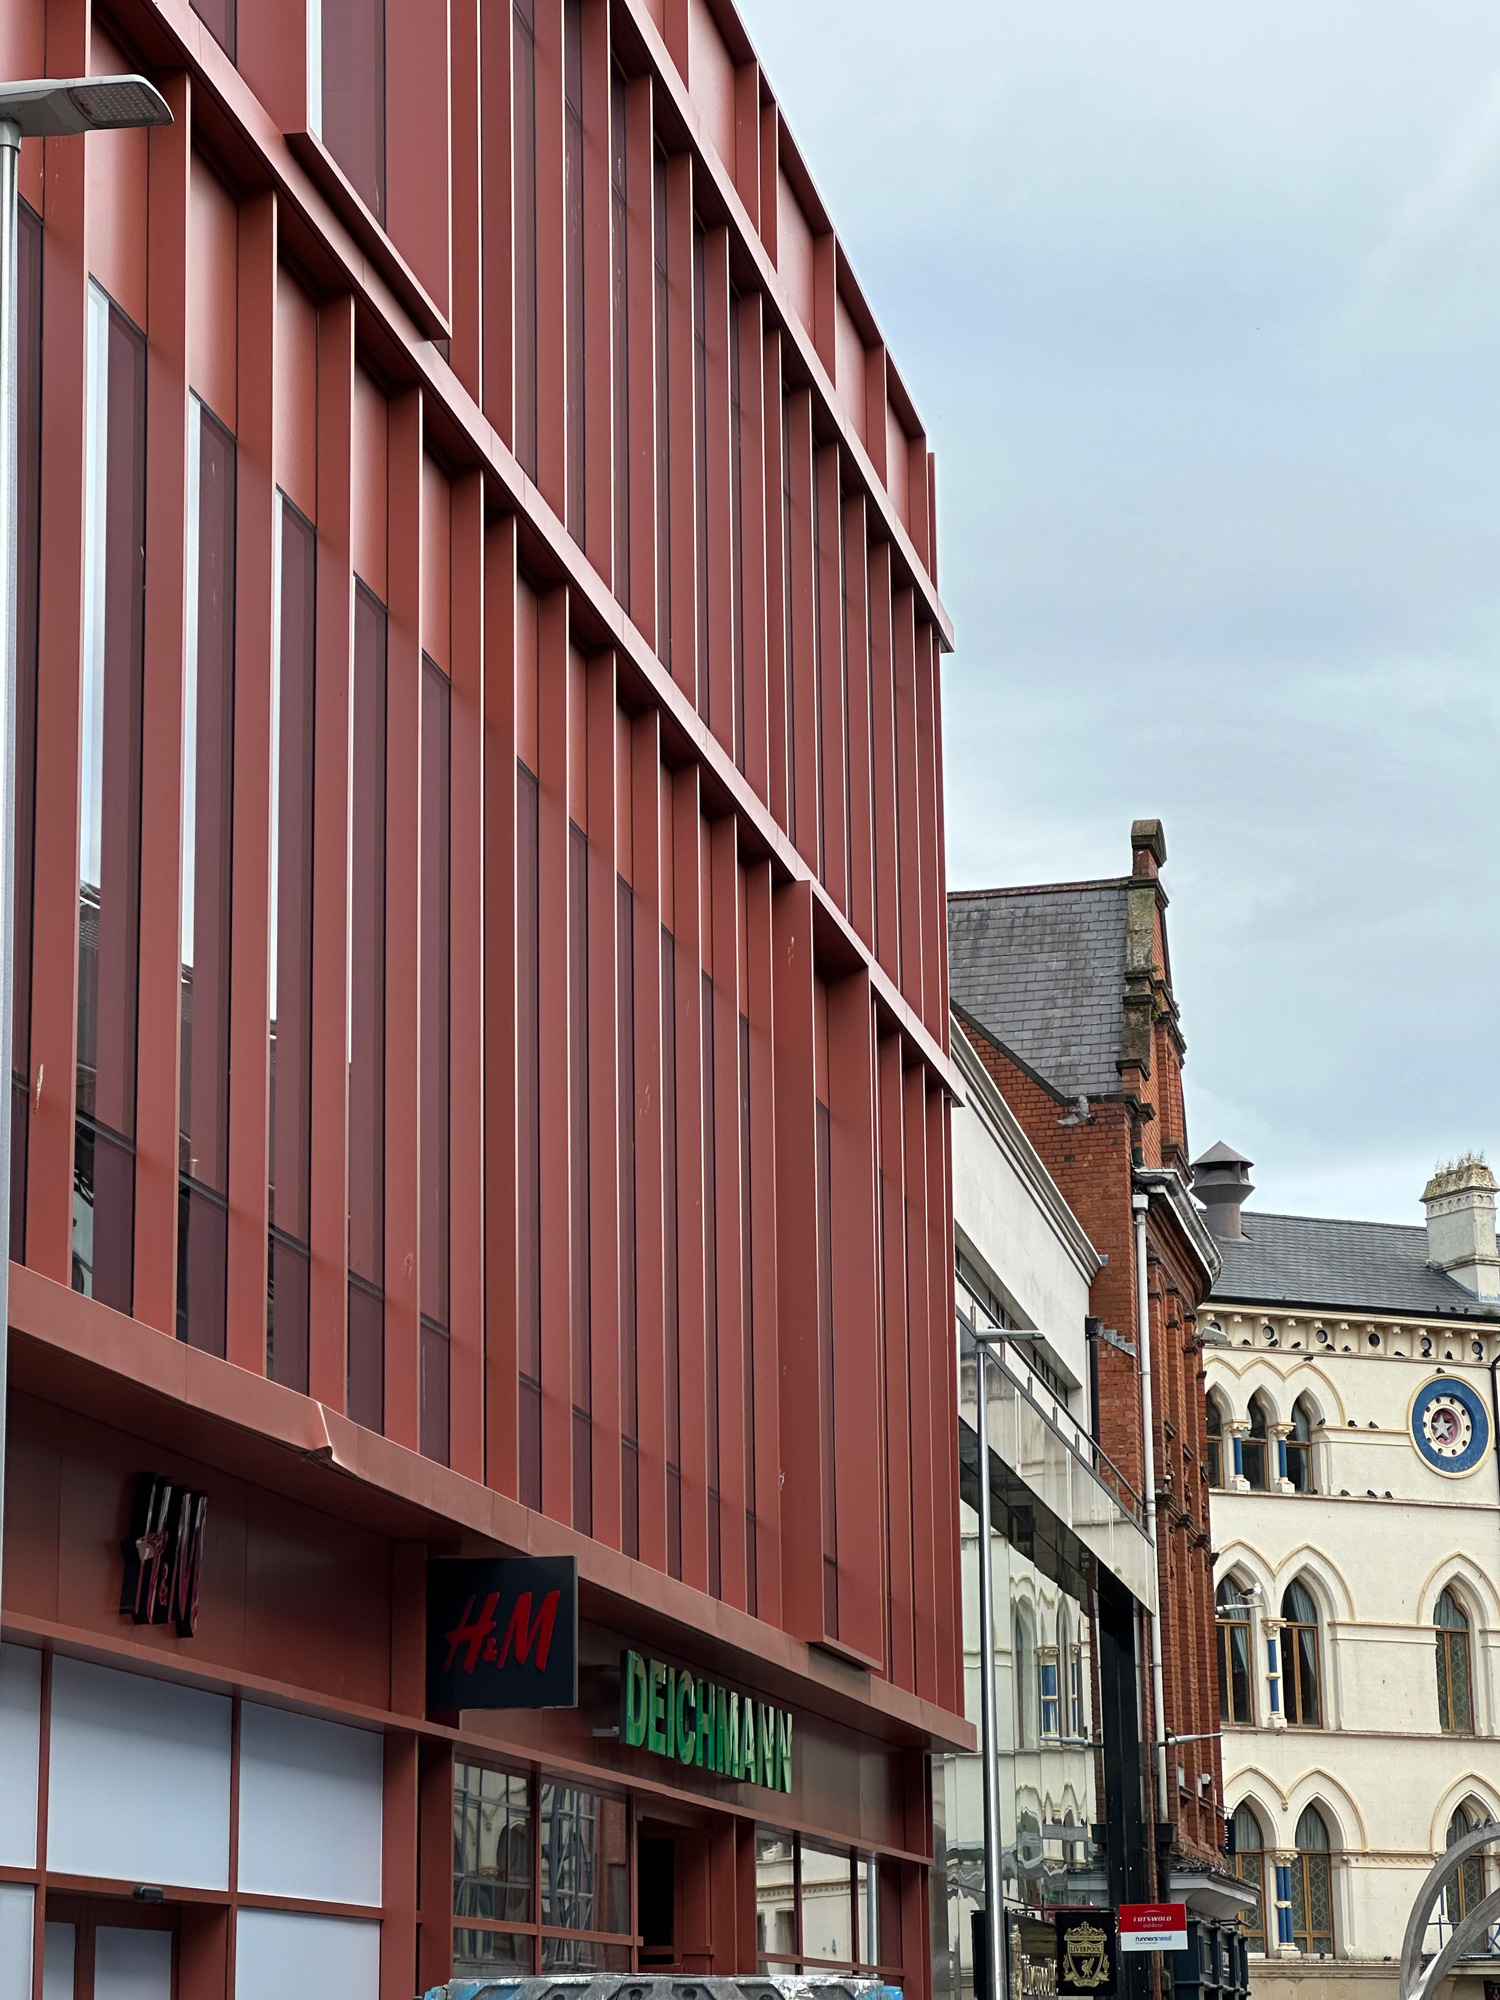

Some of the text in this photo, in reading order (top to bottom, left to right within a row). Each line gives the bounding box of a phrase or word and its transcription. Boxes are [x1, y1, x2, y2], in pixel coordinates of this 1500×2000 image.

[122, 1473, 208, 1637] H&M
[443, 1589, 561, 1675] H&M
[621, 1649, 793, 1794] DEICHMANN
